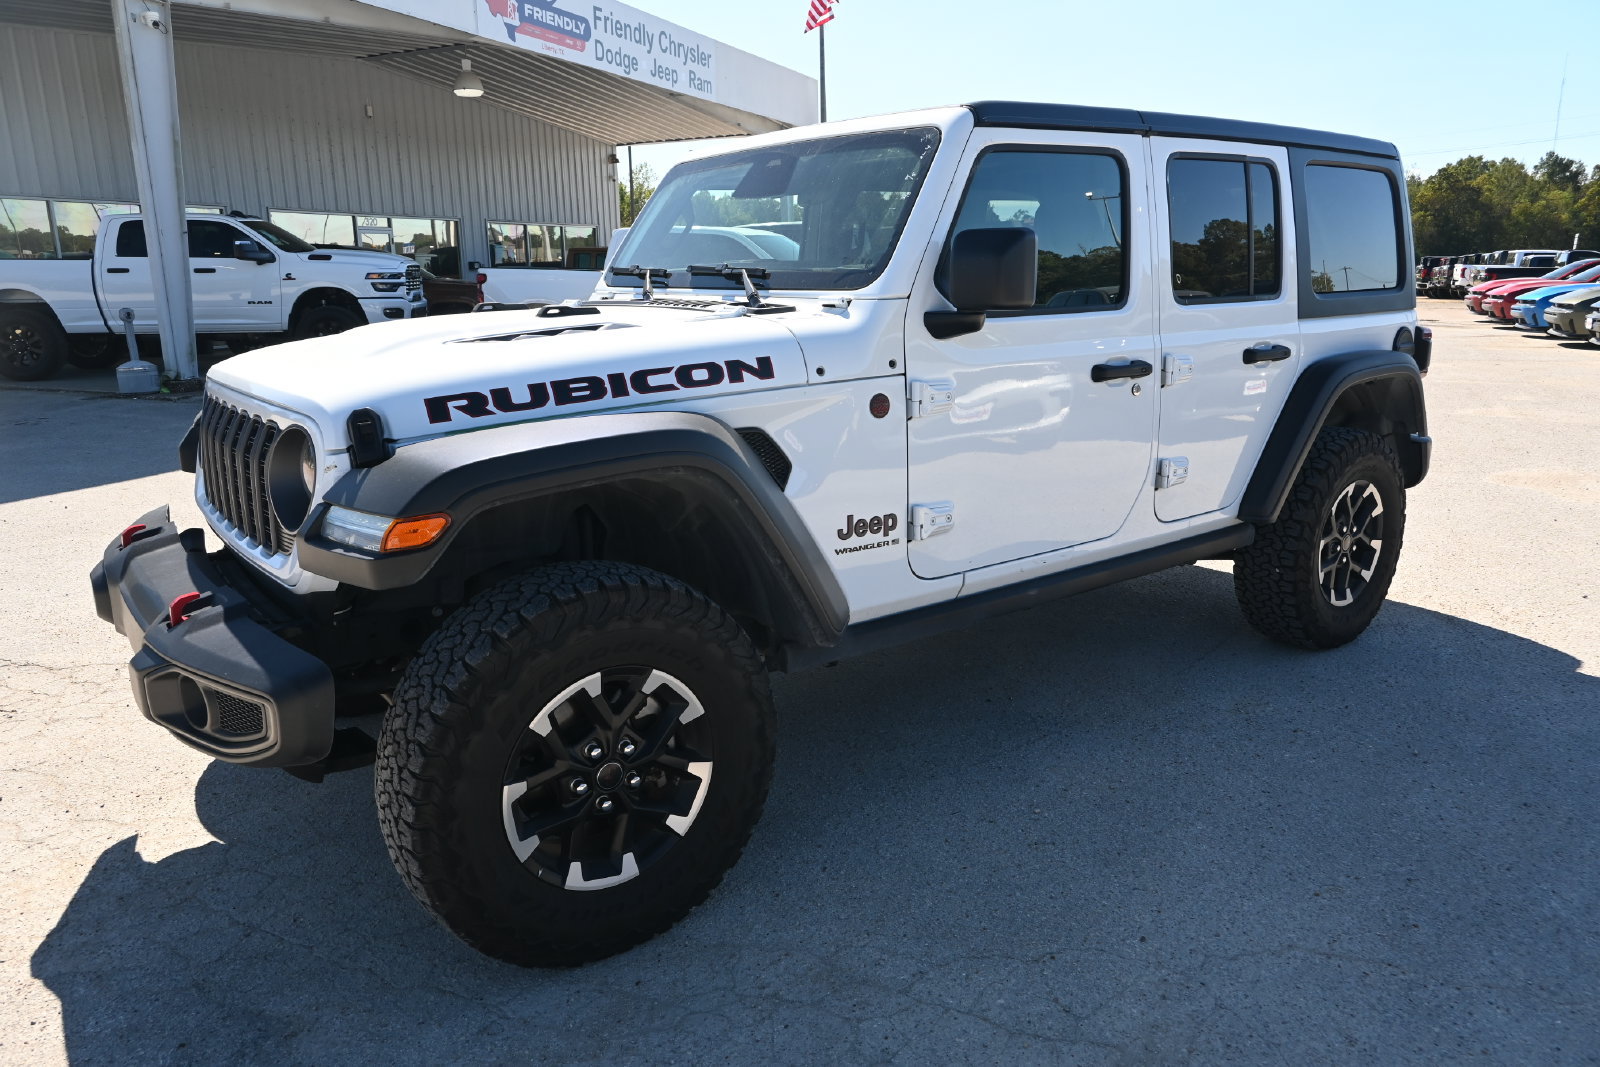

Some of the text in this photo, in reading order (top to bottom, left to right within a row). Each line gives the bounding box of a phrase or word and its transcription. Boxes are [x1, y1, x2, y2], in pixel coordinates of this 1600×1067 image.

[524, 3, 586, 35] FRIENDLY
[593, 5, 655, 54] Friendly
[658, 30, 712, 68] Chrysler
[594, 39, 713, 94] Dodge Jeep Ram
[423, 356, 776, 424] RUBICON
[834, 540, 890, 556] WRANGLER
[837, 512, 898, 541] Jeep
